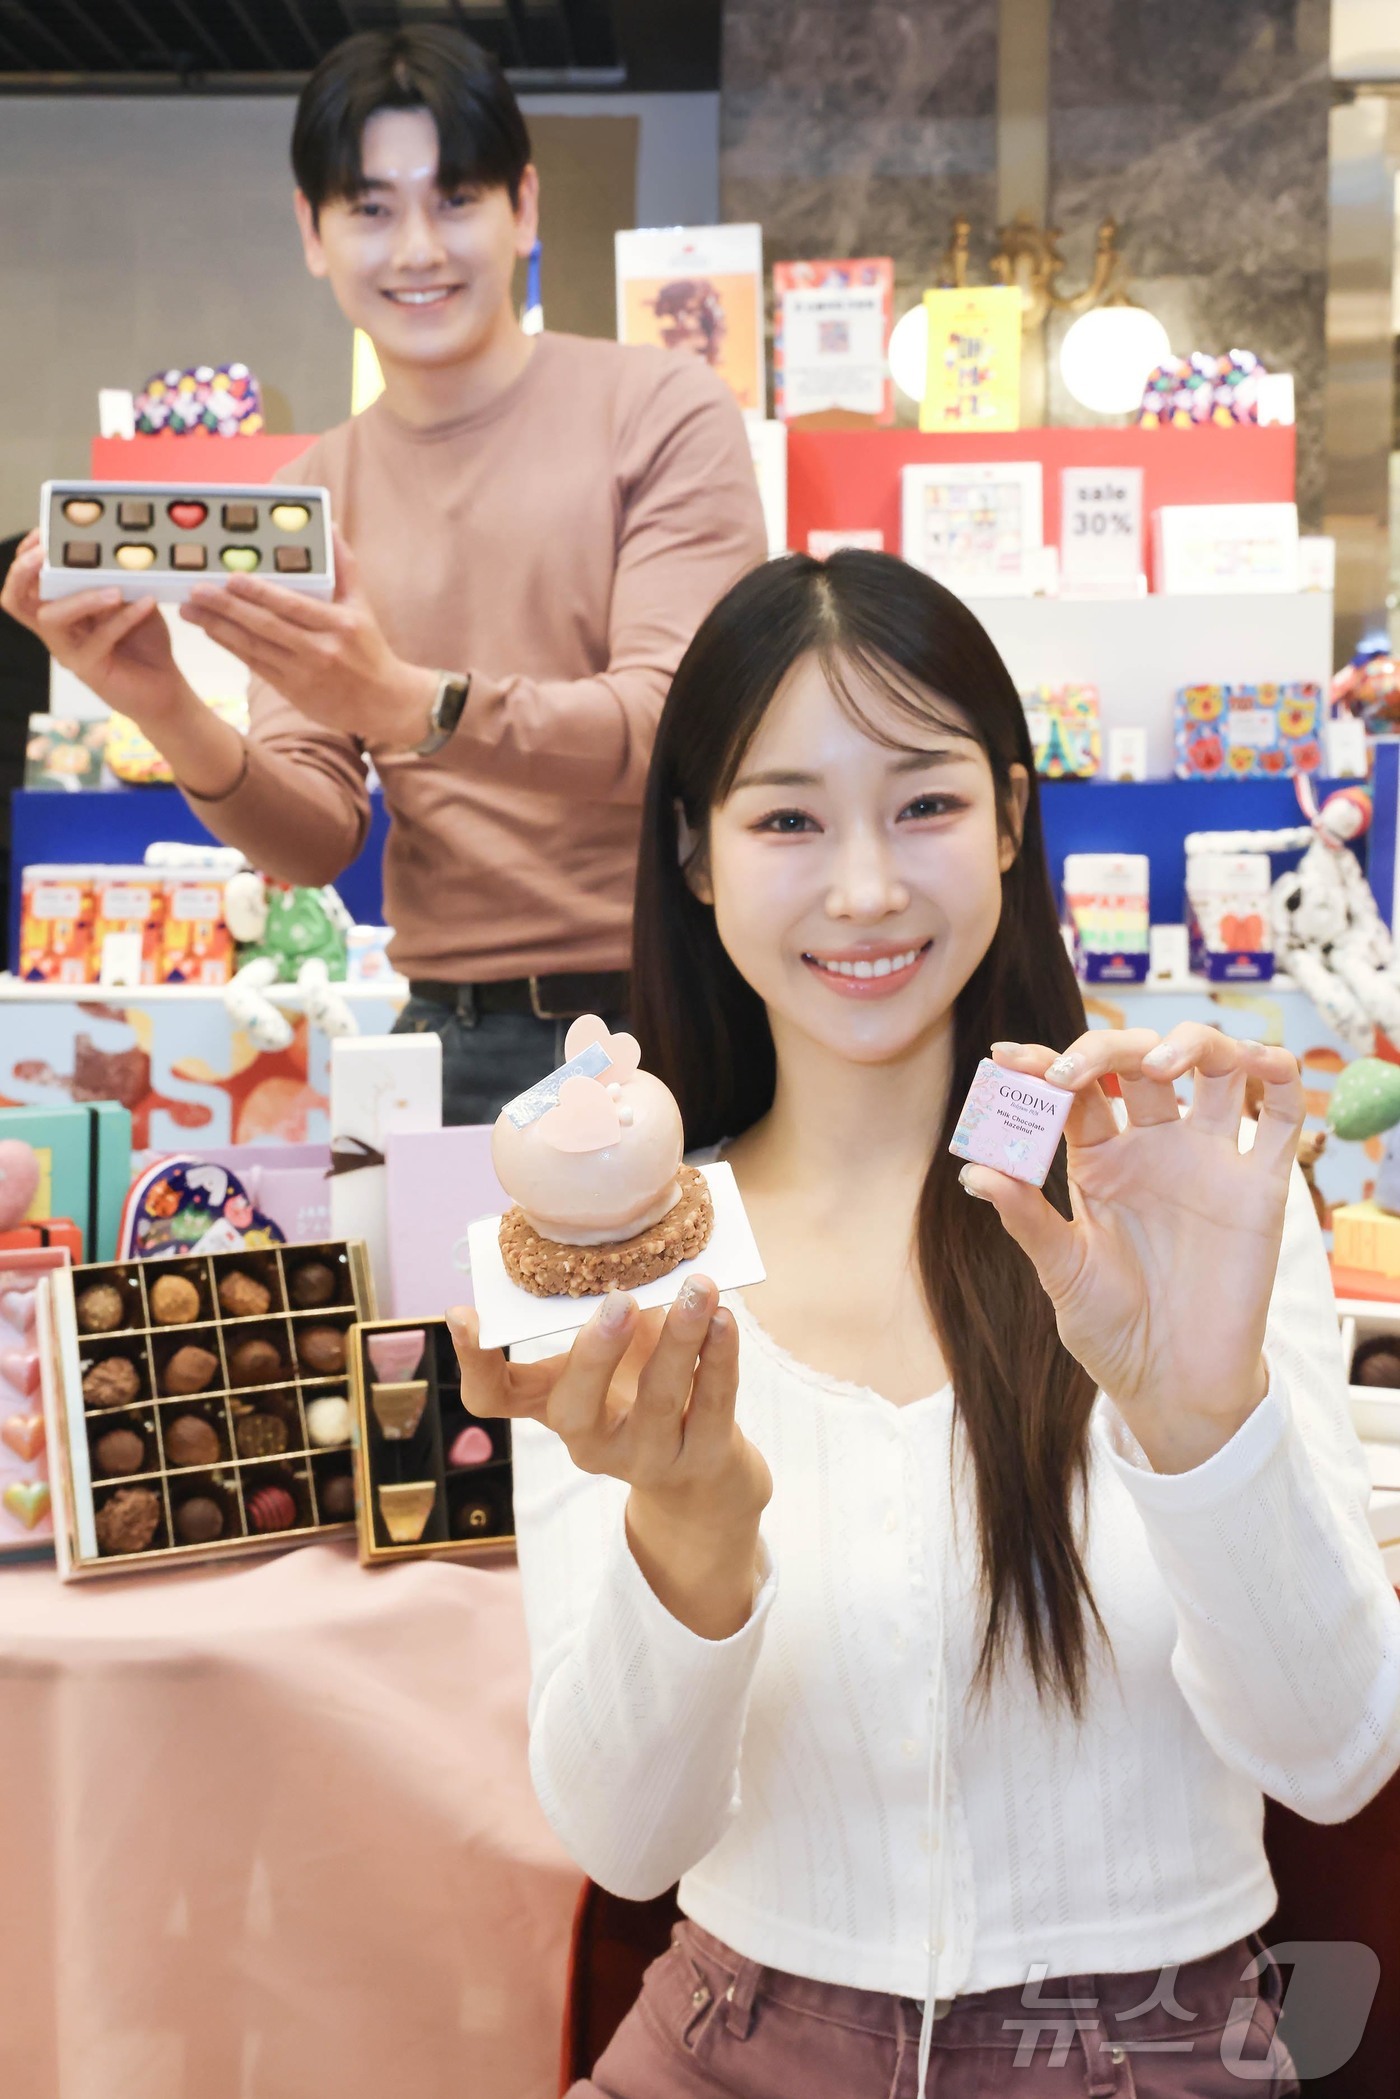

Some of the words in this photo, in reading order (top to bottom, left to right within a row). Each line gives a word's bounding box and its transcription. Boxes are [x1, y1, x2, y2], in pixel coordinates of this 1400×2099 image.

[1079, 484, 1126, 501] sale
[1073, 512, 1133, 536] 30%
[999, 1085, 1057, 1116] GODIVA
[996, 1109, 1010, 1118] Milk
[1012, 1112, 1045, 1132] Chocolate
[1003, 1120, 1033, 1135] Hazelnut
